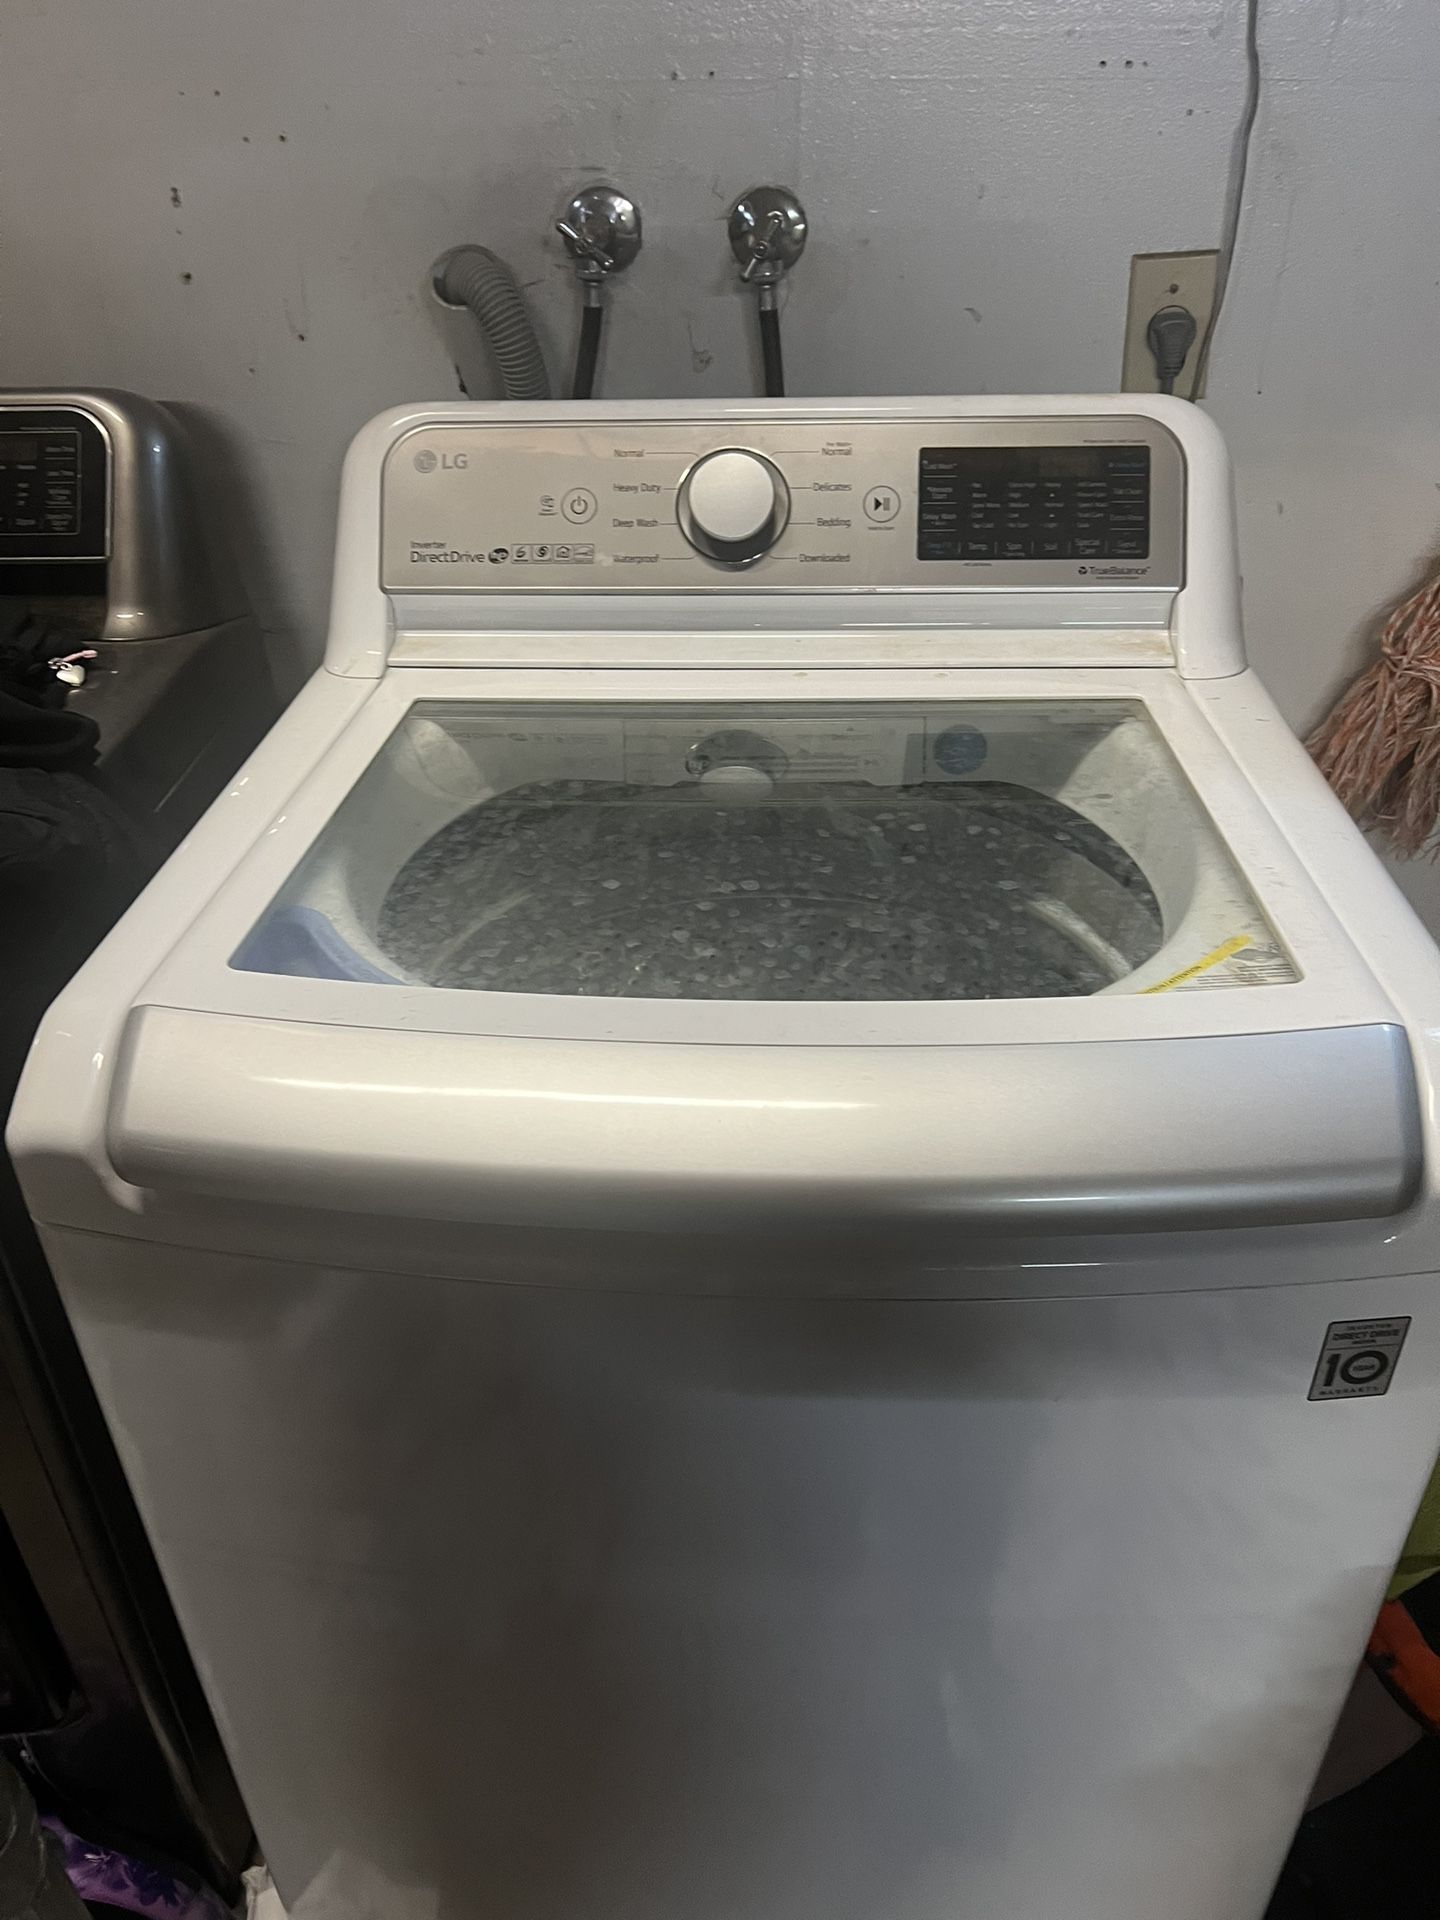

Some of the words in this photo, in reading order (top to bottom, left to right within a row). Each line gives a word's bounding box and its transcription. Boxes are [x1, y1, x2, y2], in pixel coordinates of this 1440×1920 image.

[614, 449, 645, 458] Normal
[821, 447, 853, 457] Normal
[441, 453, 468, 470] LG
[613, 482, 638, 494] Heavy
[640, 482, 661, 494] Duty
[812, 482, 853, 492] Delicates
[612, 518, 634, 529] Deep
[816, 518, 852, 530] Bedding
[410, 541, 447, 549] Inverter
[799, 553, 852, 563] Downloaded
[1323, 1350, 1389, 1386] 10
